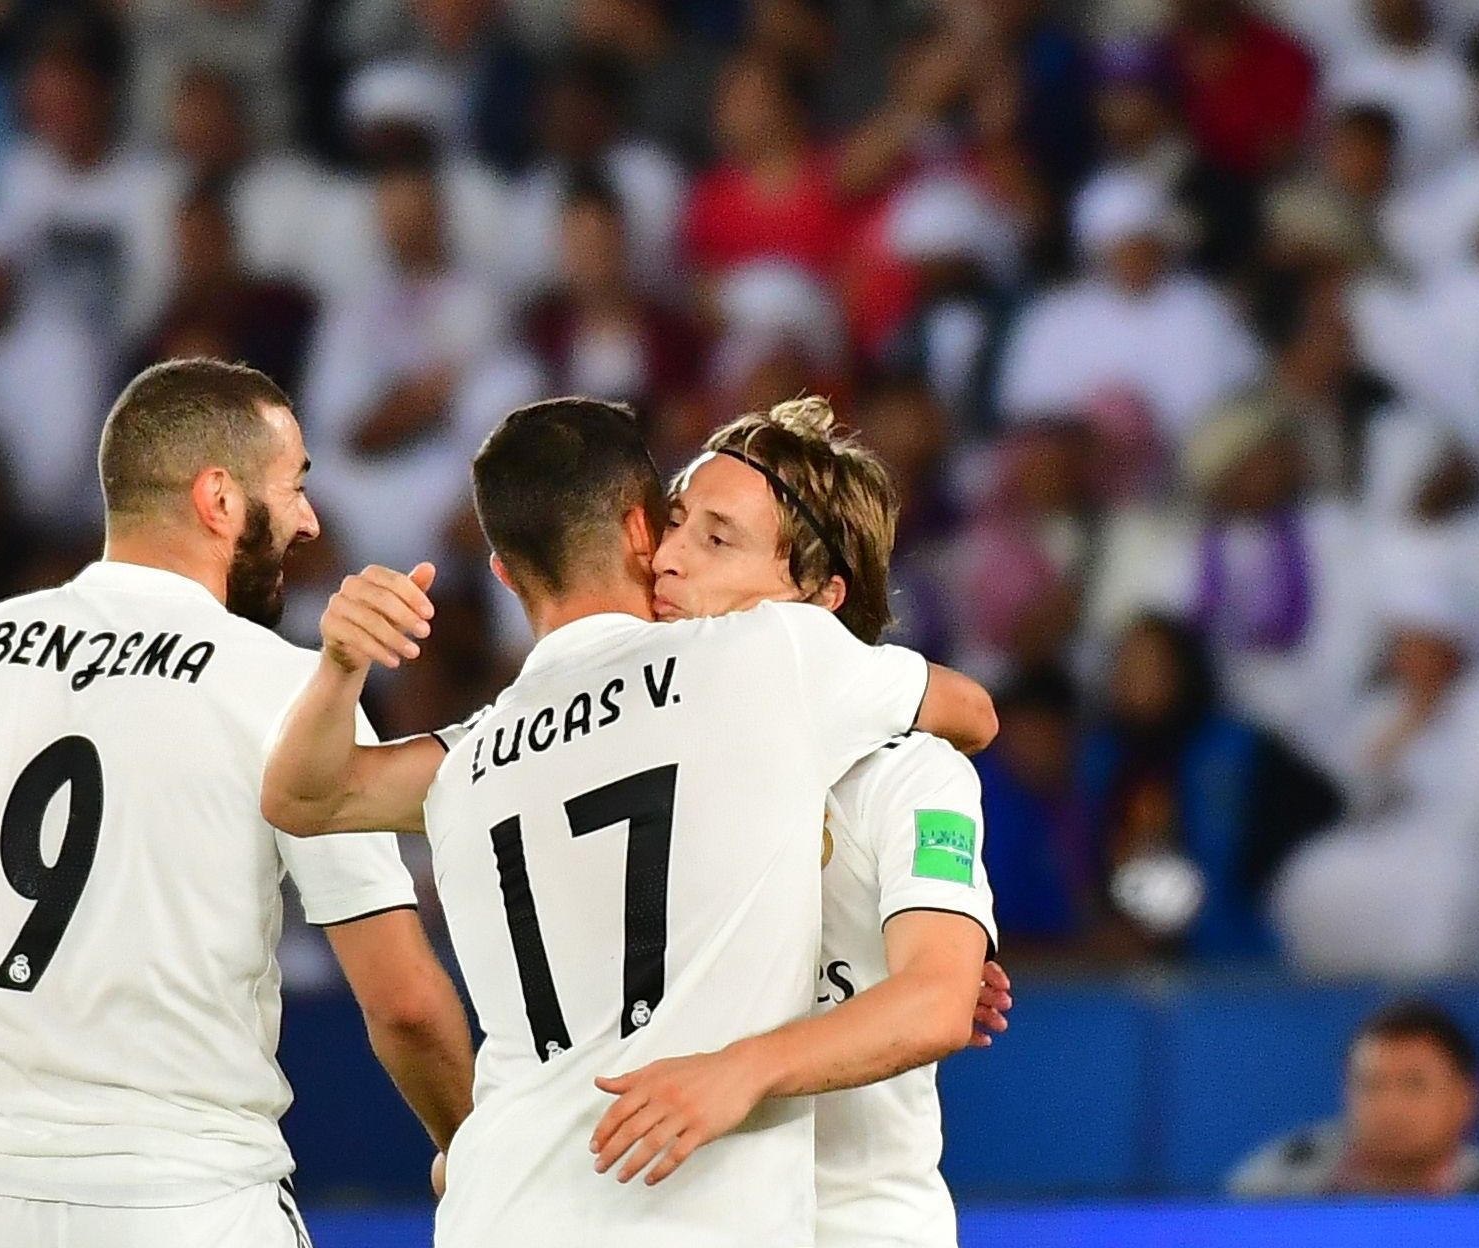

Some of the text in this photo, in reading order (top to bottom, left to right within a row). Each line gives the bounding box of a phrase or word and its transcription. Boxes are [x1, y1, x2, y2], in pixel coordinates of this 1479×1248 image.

[471, 656, 682, 785] LUCAS V.
[488, 762, 680, 1064] 17
